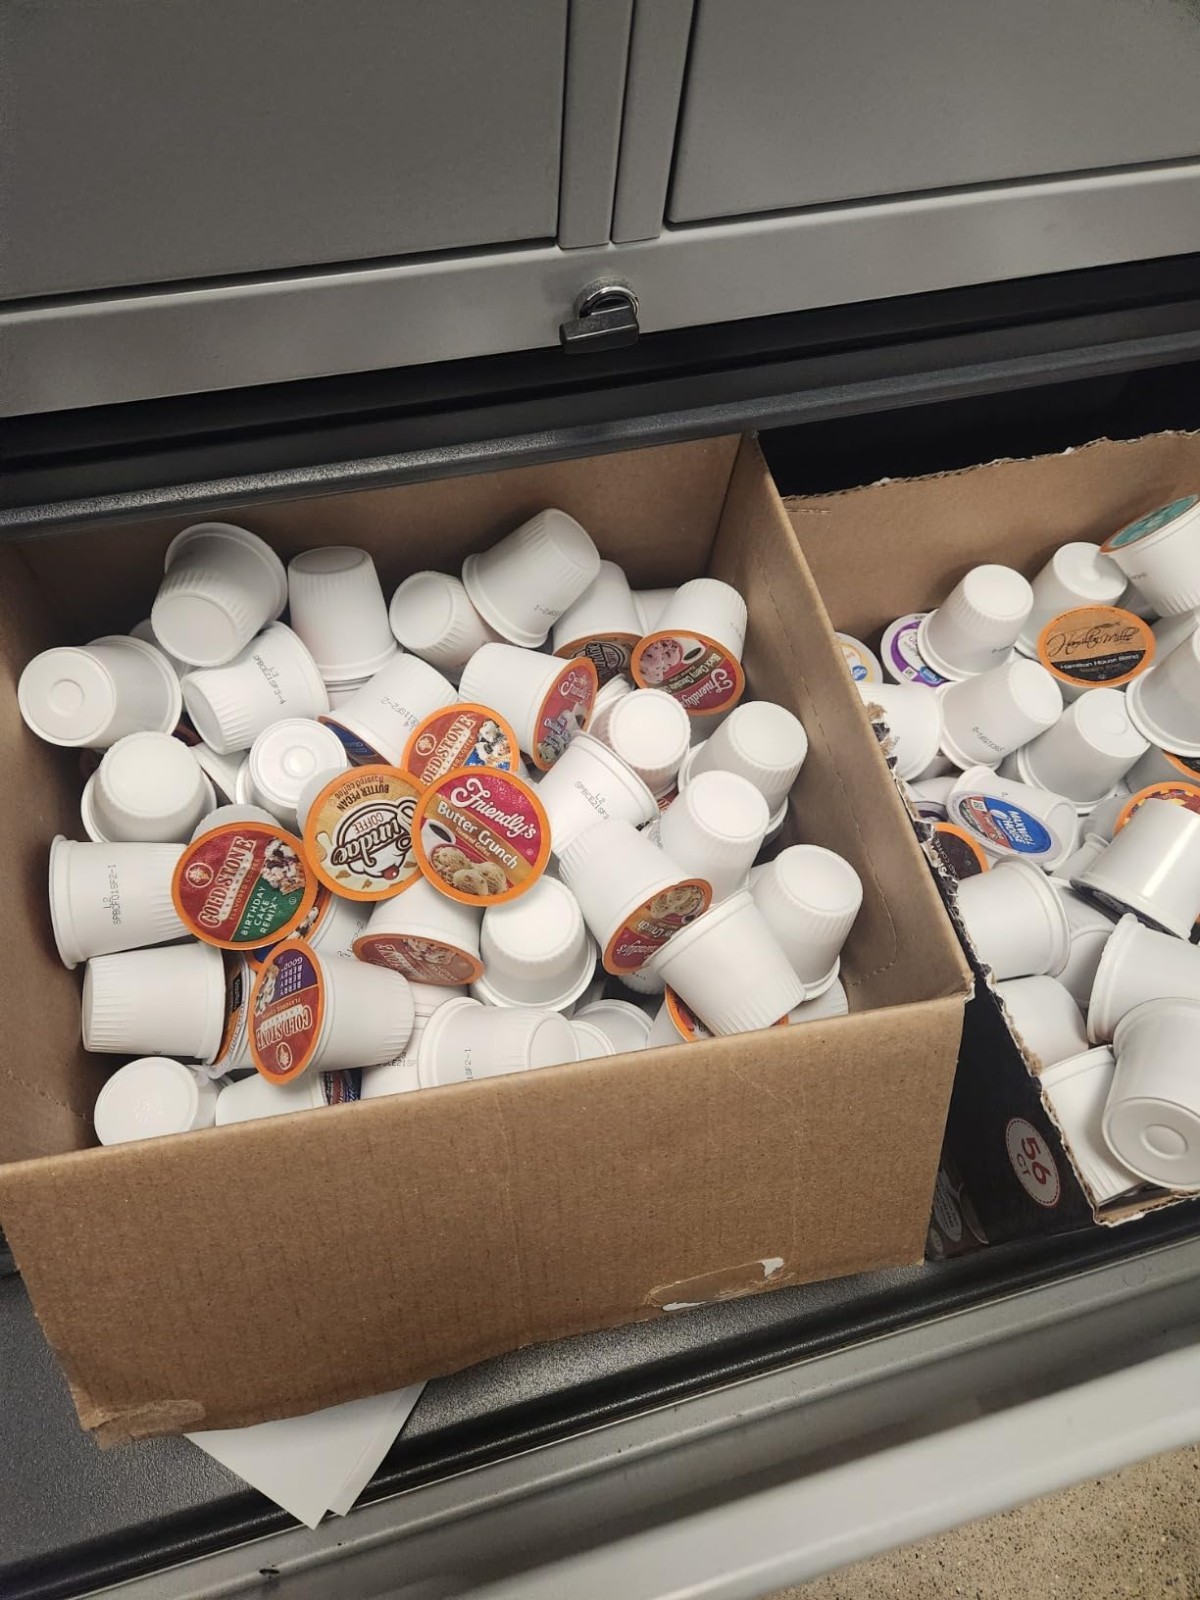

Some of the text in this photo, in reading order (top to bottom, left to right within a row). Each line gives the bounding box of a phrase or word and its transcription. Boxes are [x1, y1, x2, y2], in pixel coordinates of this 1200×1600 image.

[419, 714, 476, 784] OLD STONE
[335, 784, 388, 810] BUTTER PECAN
[450, 779, 535, 838] Friendly's
[353, 811, 383, 833] COFFEE
[437, 800, 516, 869] Butter Crunch
[1003, 820, 1025, 843] HOUSE
[198, 836, 256, 927] COLD STONE
[240, 886, 265, 935] BIRTHDAY
[254, 899, 269, 925] CAKE
[283, 1004, 312, 1036] COLD
[1018, 1154, 1030, 1175] CT
[1021, 1137, 1050, 1184] 56
